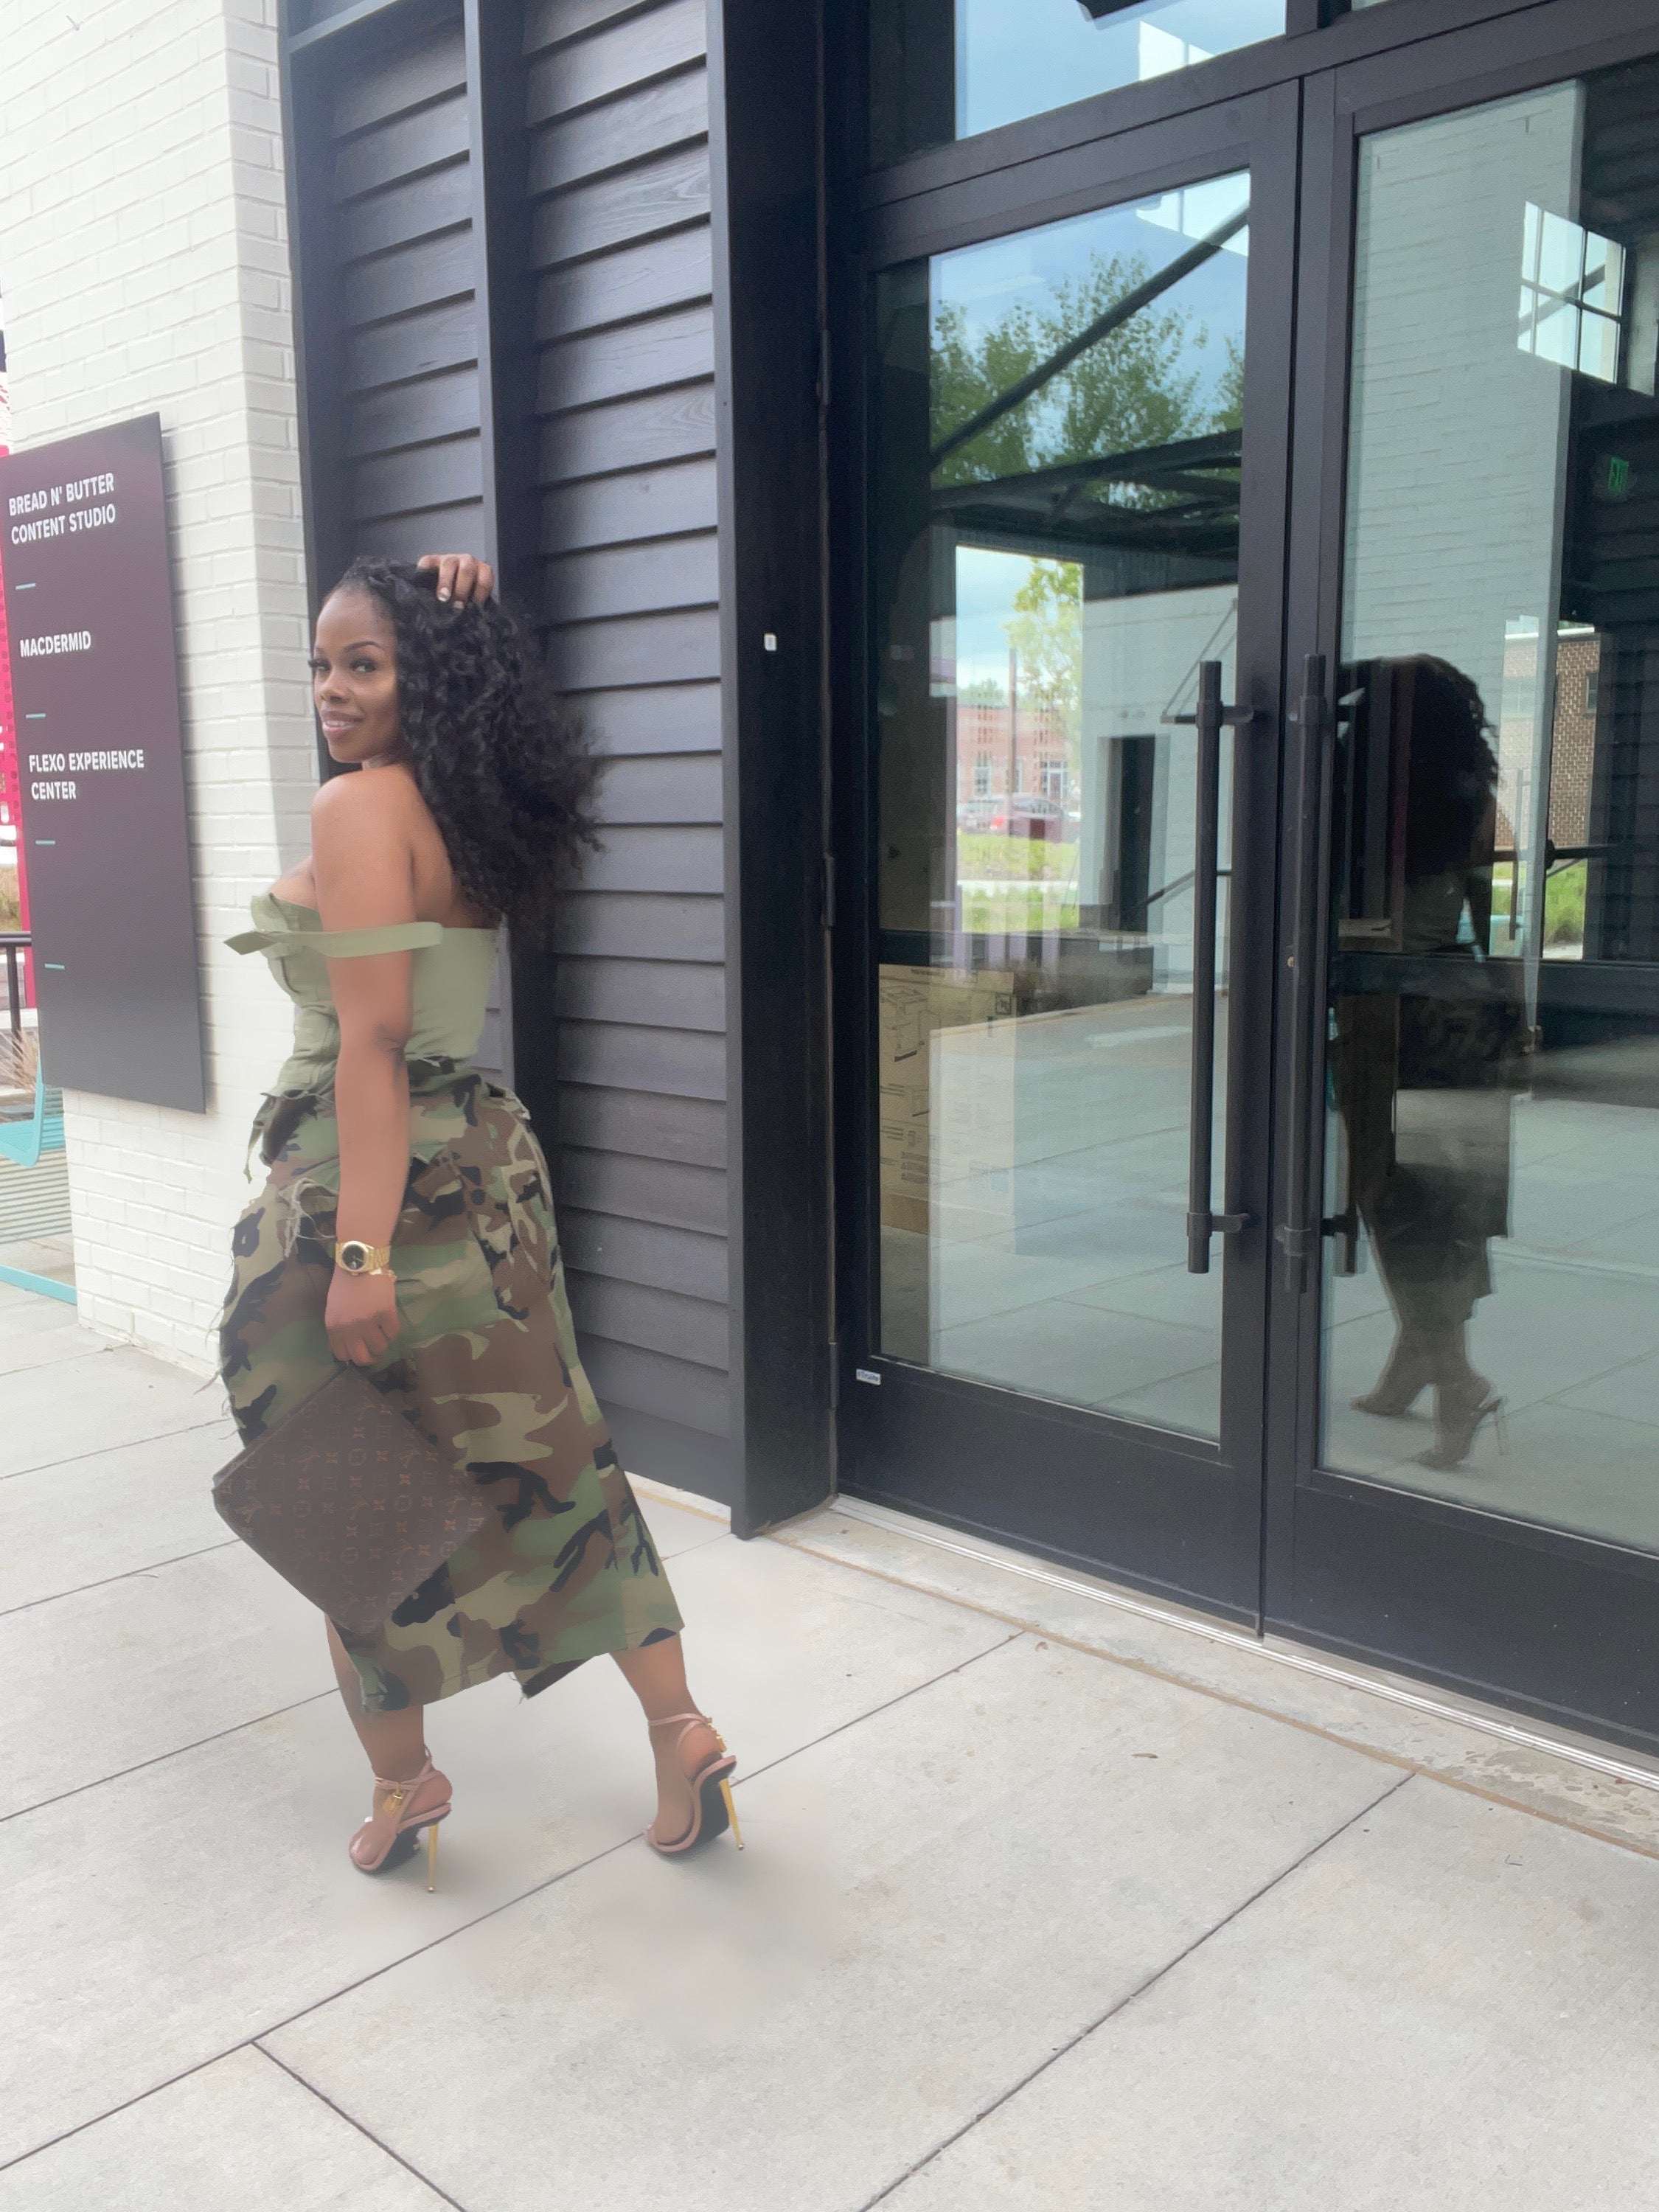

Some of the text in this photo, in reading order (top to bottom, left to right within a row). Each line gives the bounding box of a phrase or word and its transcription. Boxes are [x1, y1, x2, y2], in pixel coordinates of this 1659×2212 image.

[9, 473, 114, 516] BREAD N' BUTTER
[11, 504, 115, 544] CONTENT STUDIO
[20, 630, 91, 658] MACDERMID
[29, 749, 145, 773] FLEXO EXPERIENCE
[31, 781, 76, 800] CENTER
